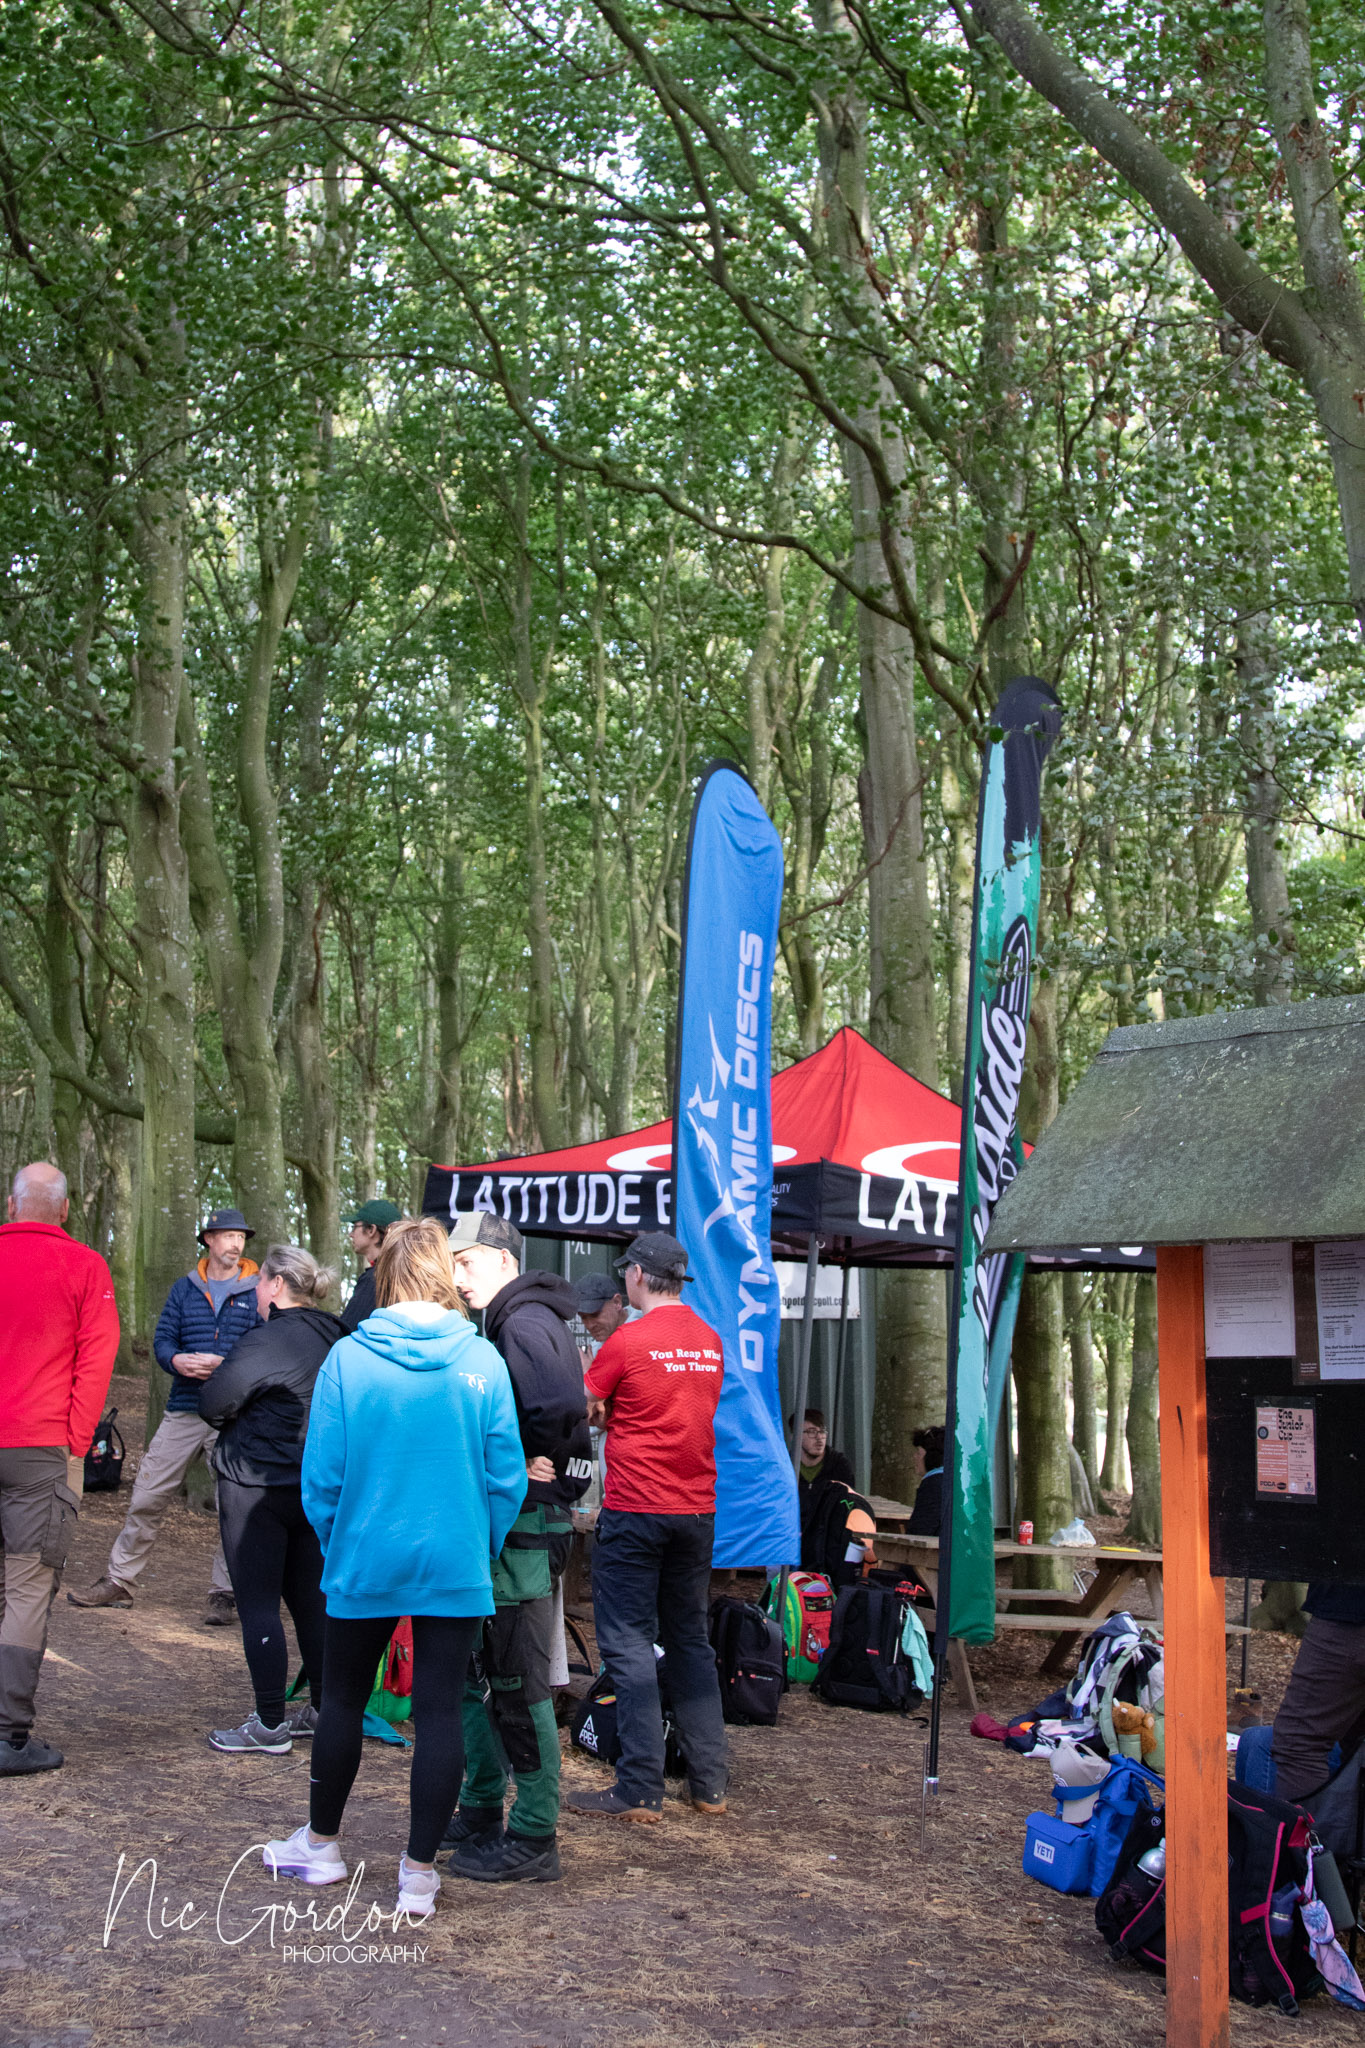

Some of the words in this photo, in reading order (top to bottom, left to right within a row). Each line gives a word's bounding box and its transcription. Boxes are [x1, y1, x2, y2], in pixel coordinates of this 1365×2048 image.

[734, 930, 764, 1090] DISCS
[449, 1173, 642, 1226] LATITUDE
[730, 1101, 770, 1373] DYNAMIC
[649, 1350, 674, 1360] You
[676, 1348, 701, 1361] Reap
[664, 1362, 686, 1373] You
[688, 1361, 718, 1373] Throw
[565, 1456, 593, 1480] ND
[1036, 1843, 1053, 1860] YETI
